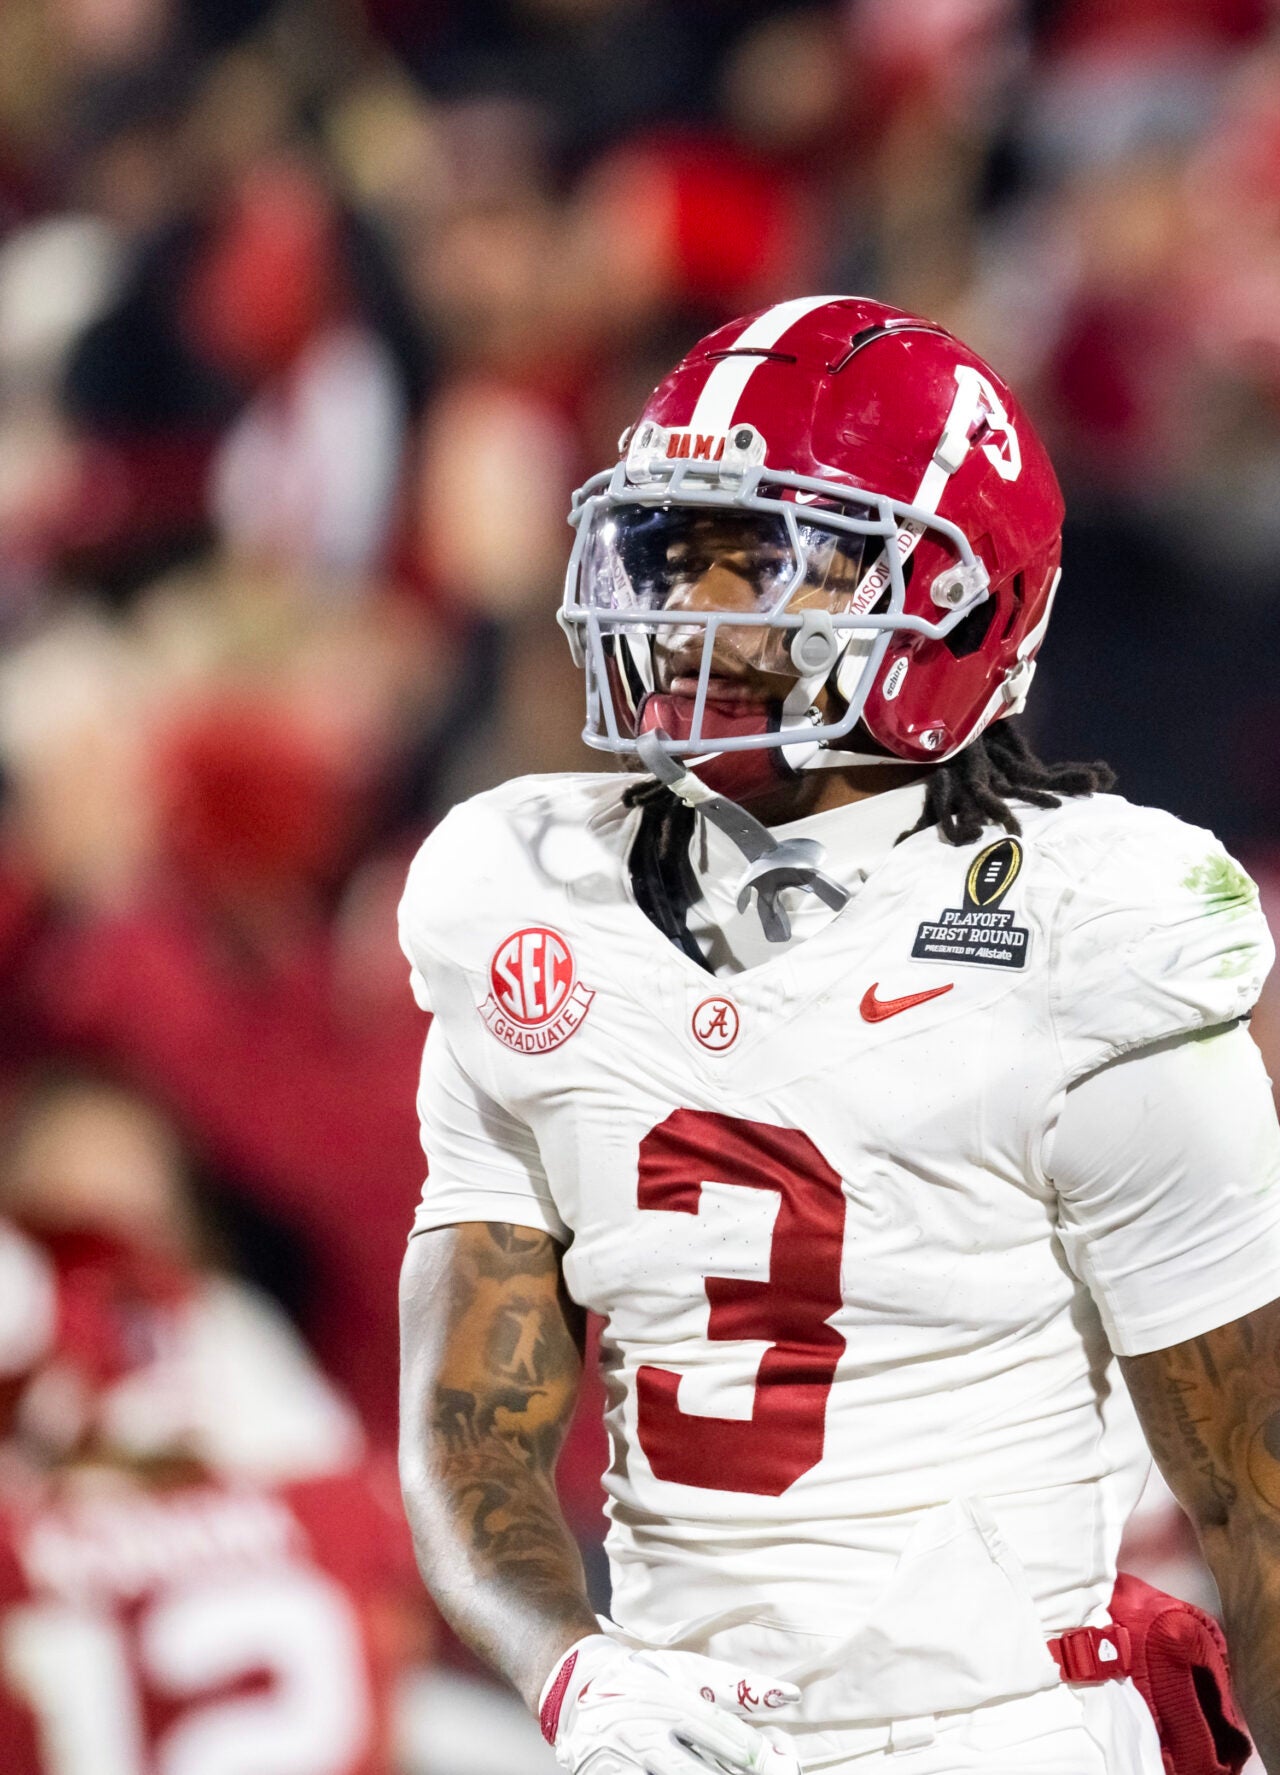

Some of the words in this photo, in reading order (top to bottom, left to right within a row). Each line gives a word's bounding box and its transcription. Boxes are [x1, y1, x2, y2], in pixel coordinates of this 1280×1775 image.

[920, 925, 969, 942] FIRST
[969, 928, 1025, 946] ROUND
[942, 912, 1011, 927] PLAYOFF
[924, 944, 965, 955] PRESENTED
[965, 946, 976, 955] BY
[975, 947, 1013, 961] Allstate
[495, 933, 568, 1019] SEC
[494, 1008, 578, 1051] GRADUATE
[636, 1106, 847, 1497] 3
